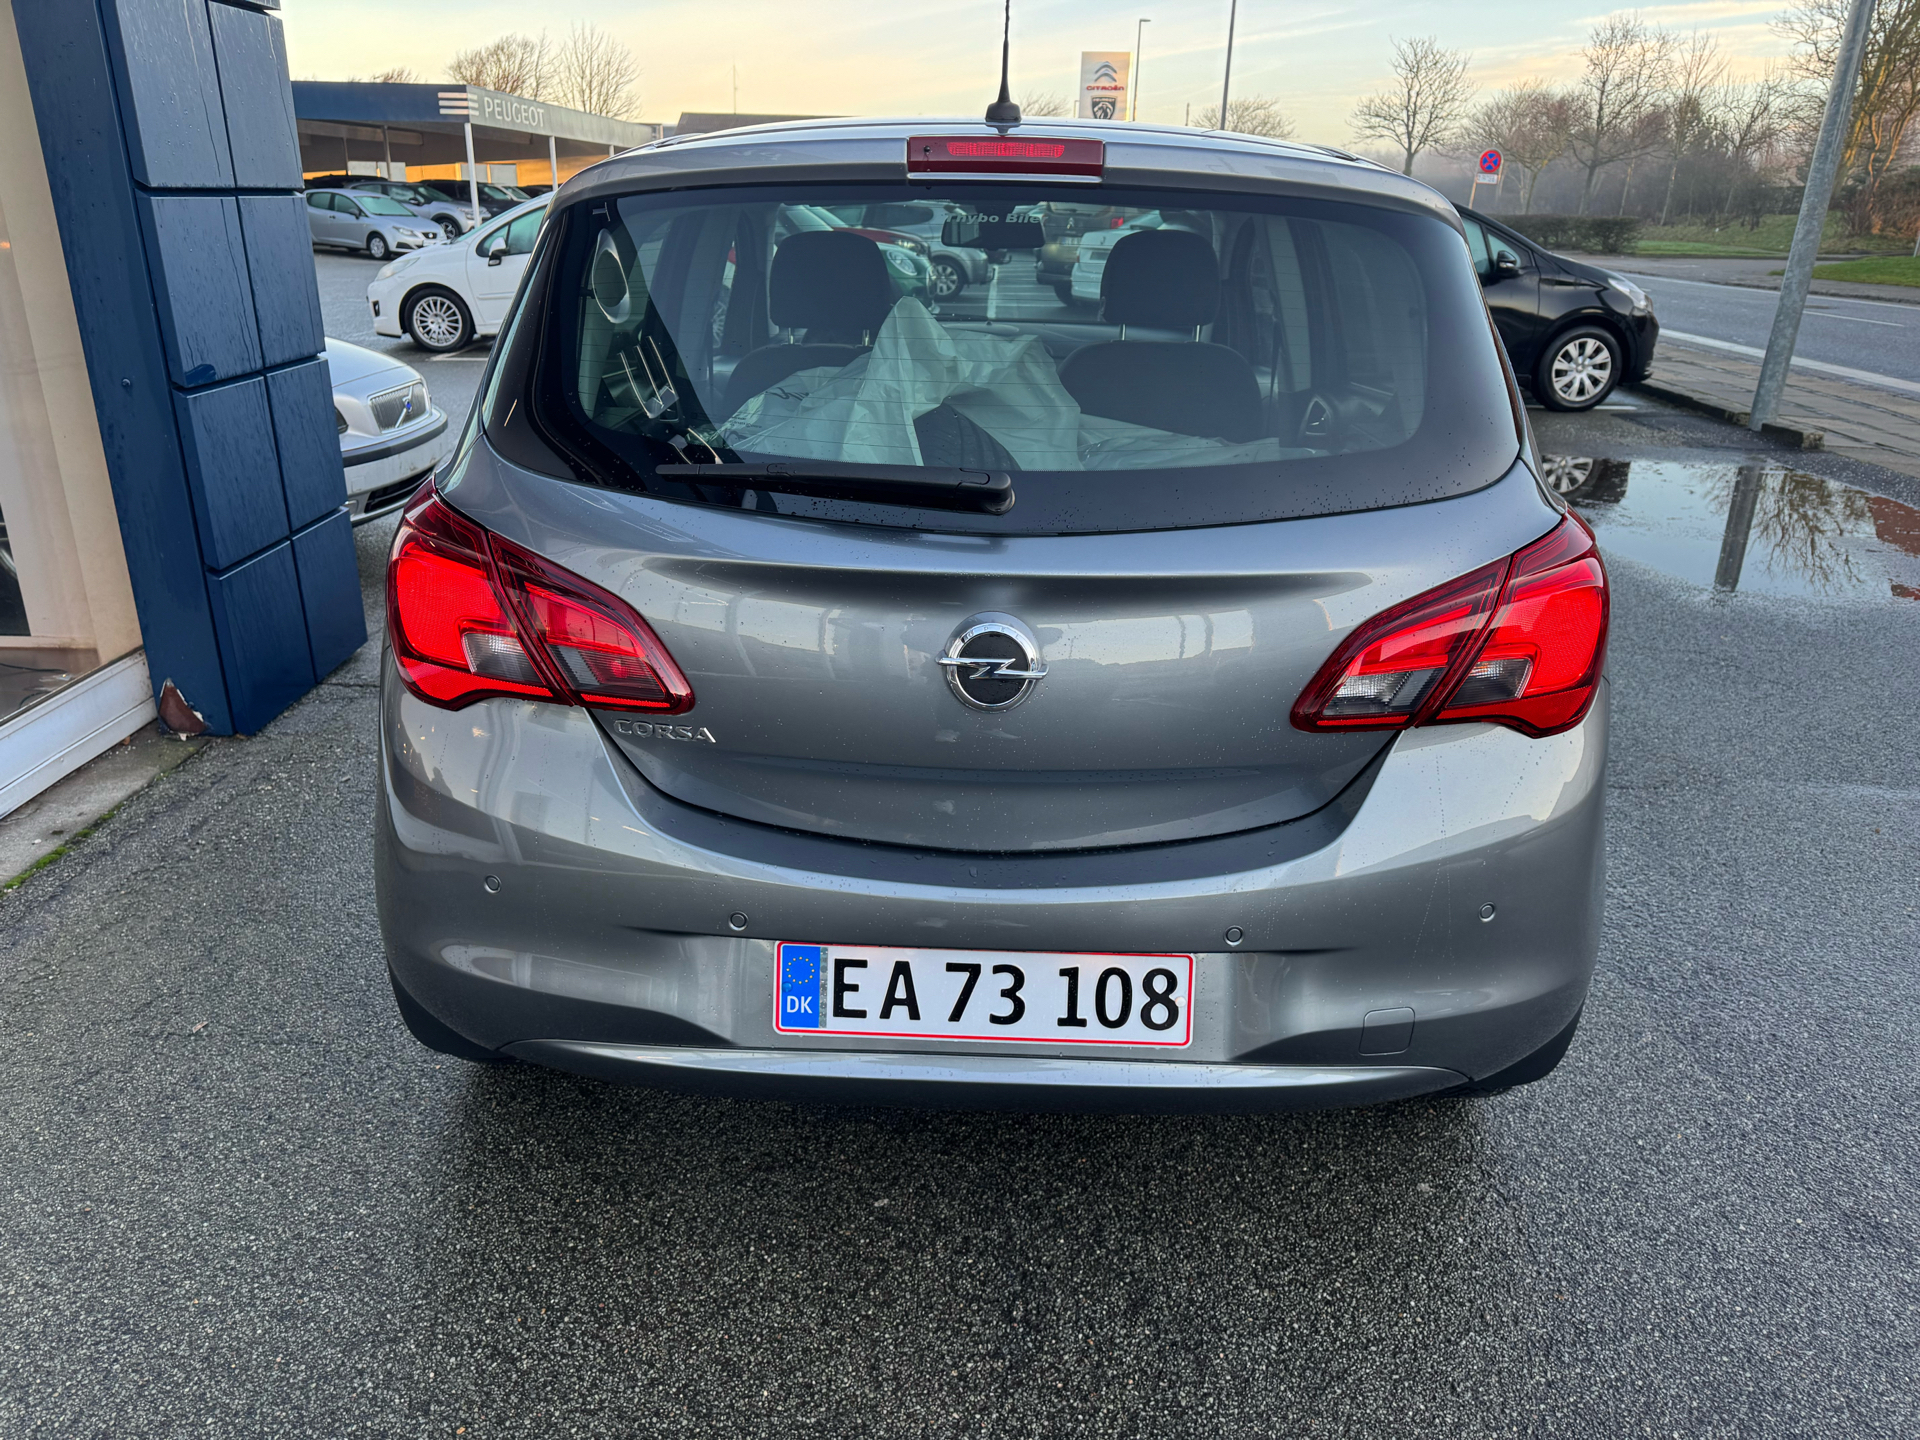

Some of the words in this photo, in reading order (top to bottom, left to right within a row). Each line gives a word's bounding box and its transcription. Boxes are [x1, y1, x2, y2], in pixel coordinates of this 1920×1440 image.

[484, 96, 545, 128] PEUGEOT
[945, 212, 1000, 225] Thybo
[1005, 212, 1049, 224] Biler
[613, 719, 717, 743] CORSA
[786, 995, 813, 1014] DK
[832, 957, 921, 1021] EA
[945, 961, 1026, 1026] 73
[1057, 966, 1180, 1031] 108
